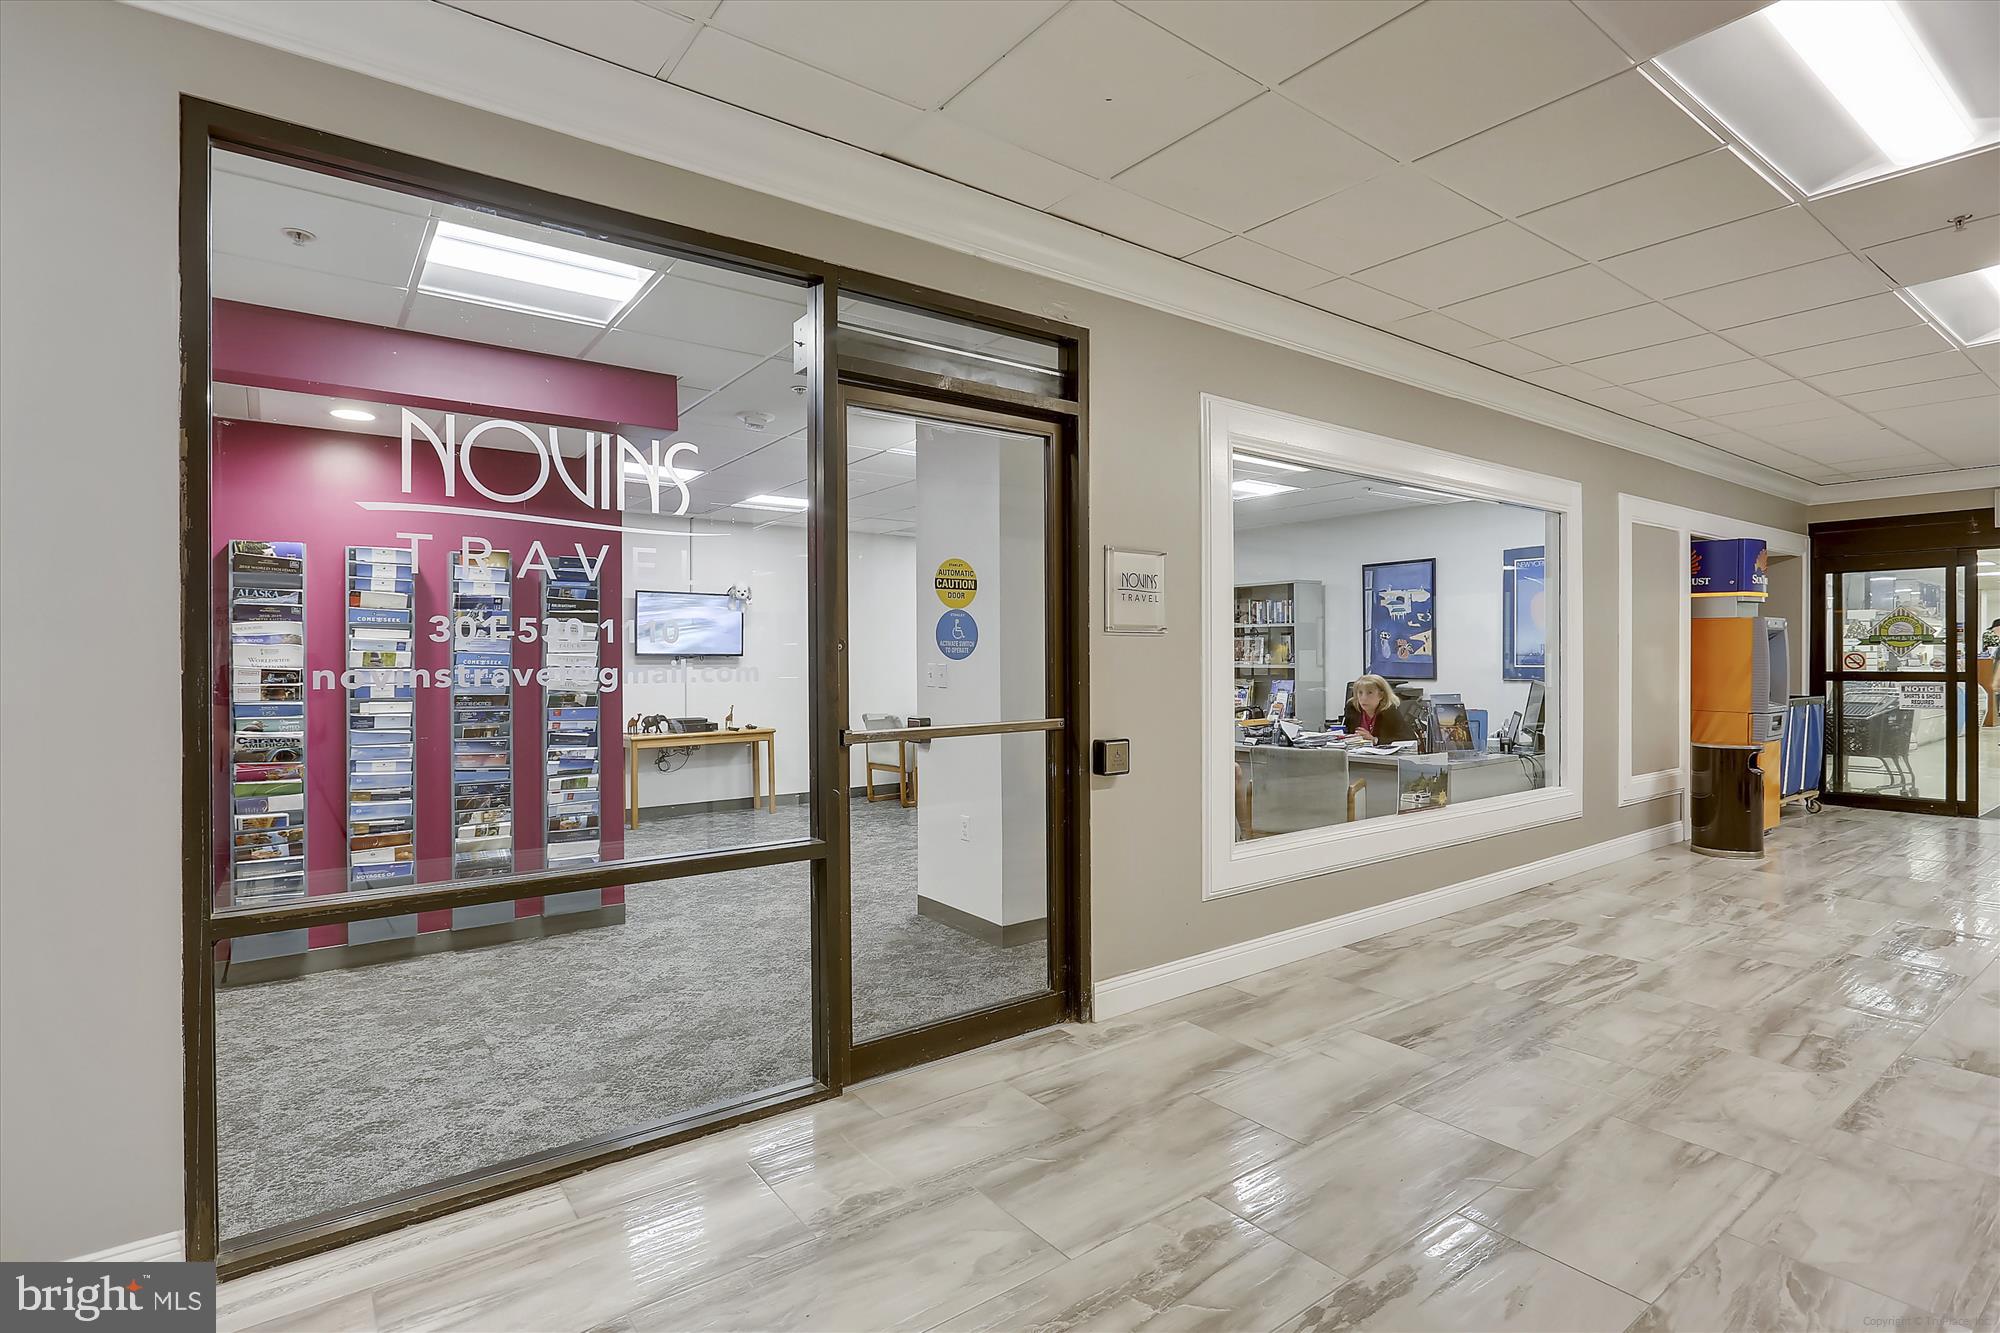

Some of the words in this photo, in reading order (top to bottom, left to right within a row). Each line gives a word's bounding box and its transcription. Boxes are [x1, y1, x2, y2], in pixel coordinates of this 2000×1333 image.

[402, 407, 699, 516] NOVINS
[938, 568, 975, 578] AUTOMATIC
[936, 578, 975, 590] CAUTION
[1121, 572, 1159, 590] NOVINS
[237, 588, 279, 598] ALASKA
[947, 591, 966, 600] DOOR
[1121, 593, 1160, 603] TRAVEL
[236, 736, 301, 745] Caravan
